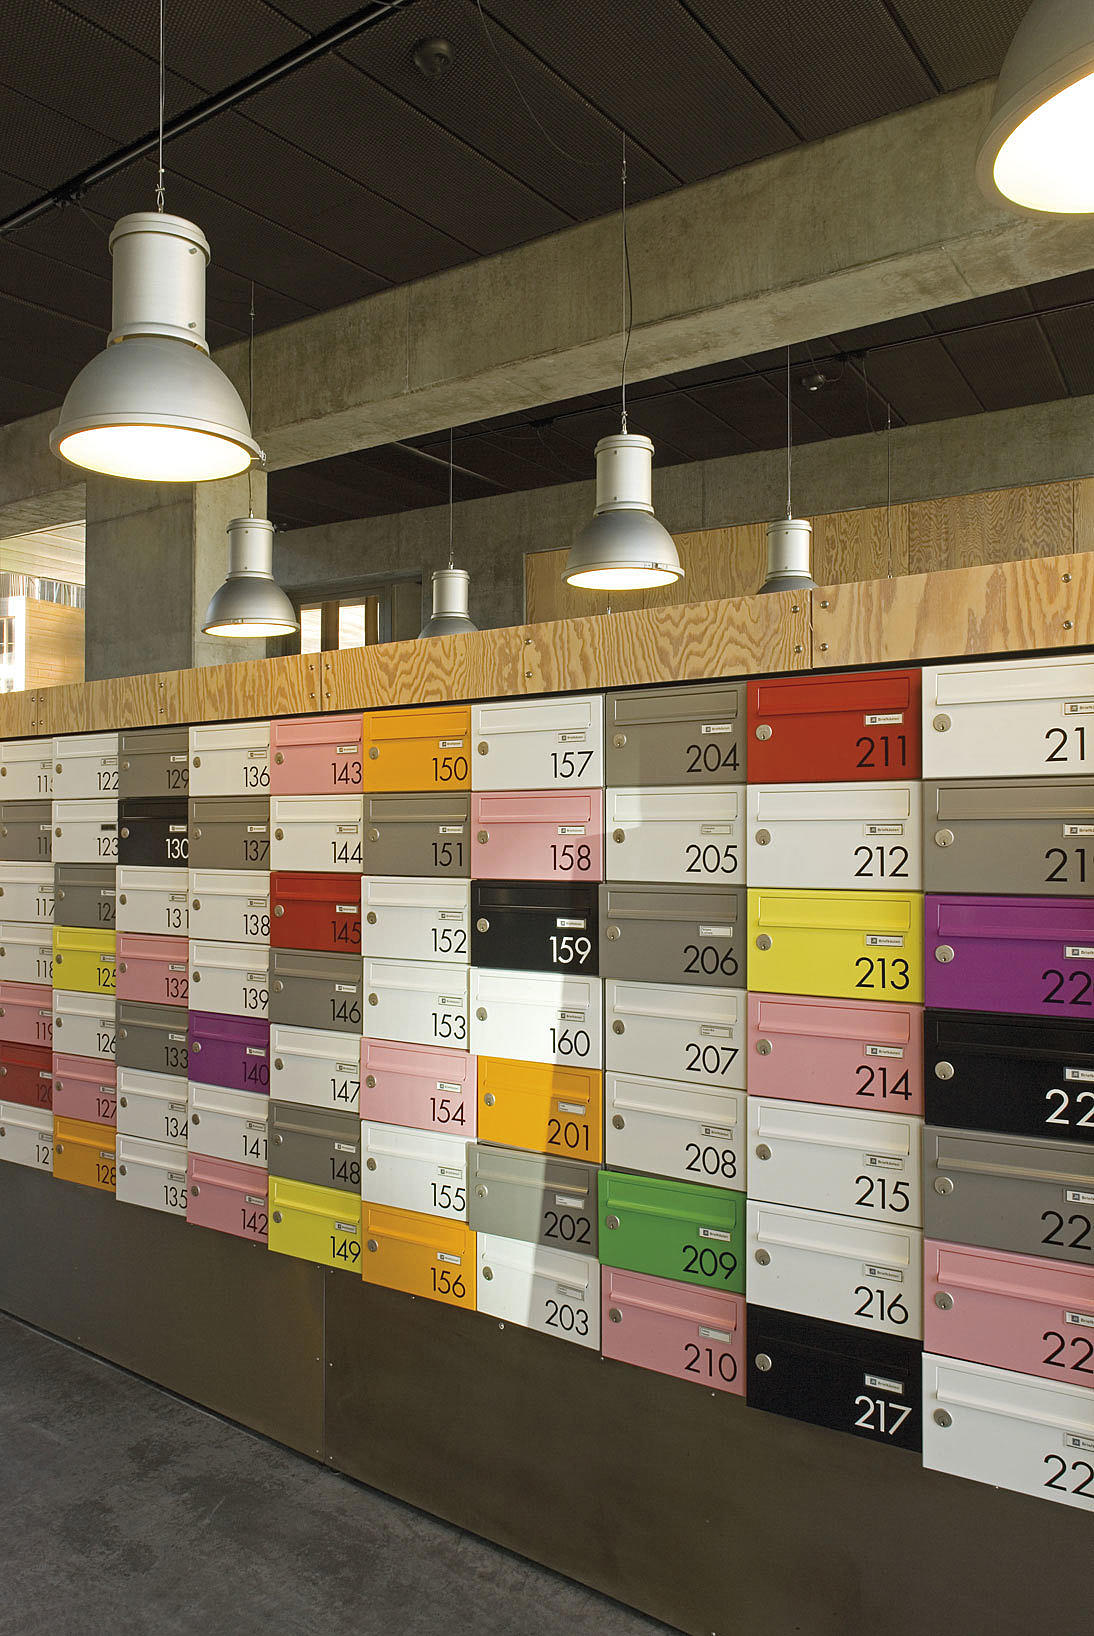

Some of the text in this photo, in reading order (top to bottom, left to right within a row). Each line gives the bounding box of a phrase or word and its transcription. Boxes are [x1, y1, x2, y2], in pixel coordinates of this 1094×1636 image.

[687, 743, 739, 772] 204
[856, 735, 906, 768] 211
[1045, 727, 1085, 762] 21
[243, 766, 270, 787] 136
[332, 762, 362, 785] 143
[432, 757, 468, 782] 150
[551, 750, 594, 779] 157
[97, 772, 119, 790] 122
[166, 769, 189, 789] 129
[38, 837, 52, 855] 11
[97, 837, 119, 856] 123
[166, 838, 189, 859] 130
[243, 840, 270, 861] 137
[332, 841, 363, 864] 144
[432, 842, 463, 866] 151
[551, 844, 591, 871] 158
[686, 844, 737, 873] 205
[854, 846, 909, 877] 212
[1045, 848, 1085, 882] 21
[36, 898, 55, 916] 117
[166, 908, 189, 928] 131
[243, 914, 270, 937] 138
[332, 921, 361, 944] 145
[432, 928, 466, 954] 152
[549, 936, 591, 964] 159
[684, 945, 738, 976] 206
[855, 957, 909, 990] 213
[165, 977, 188, 999] 132
[243, 987, 269, 1010] 139
[1042, 969, 1094, 1005] 22
[330, 999, 361, 1024] 146
[432, 1013, 466, 1040] 153
[97, 1033, 116, 1054] 126
[549, 1028, 590, 1057] 160
[164, 1047, 188, 1068] 133
[686, 1043, 739, 1076] 207
[242, 1061, 269, 1086] 140
[856, 1065, 912, 1101] 214
[331, 1079, 360, 1103] 147
[97, 1098, 116, 1119] 127
[430, 1097, 466, 1126] 154
[1045, 1089, 1094, 1127] 22
[165, 1117, 188, 1138] 134
[548, 1119, 590, 1151] 201
[36, 1145, 53, 1165] 12
[243, 1135, 268, 1159] 141
[685, 1143, 737, 1178] 208
[97, 1164, 116, 1186] 128
[330, 1157, 361, 1185] 148
[164, 1185, 188, 1209] 135
[431, 1183, 466, 1212] 155
[855, 1175, 909, 1212] 215
[241, 1209, 268, 1235] 142
[544, 1211, 591, 1244] 202
[1041, 1211, 1093, 1250] 22
[330, 1235, 361, 1263] 149
[682, 1244, 737, 1280] 209
[431, 1267, 466, 1298] 156
[545, 1300, 589, 1335] 203
[854, 1285, 908, 1324] 216
[684, 1343, 737, 1382] 210
[1043, 1331, 1094, 1374] 22
[855, 1395, 912, 1435] 217
[1044, 1454, 1094, 1498] 22
